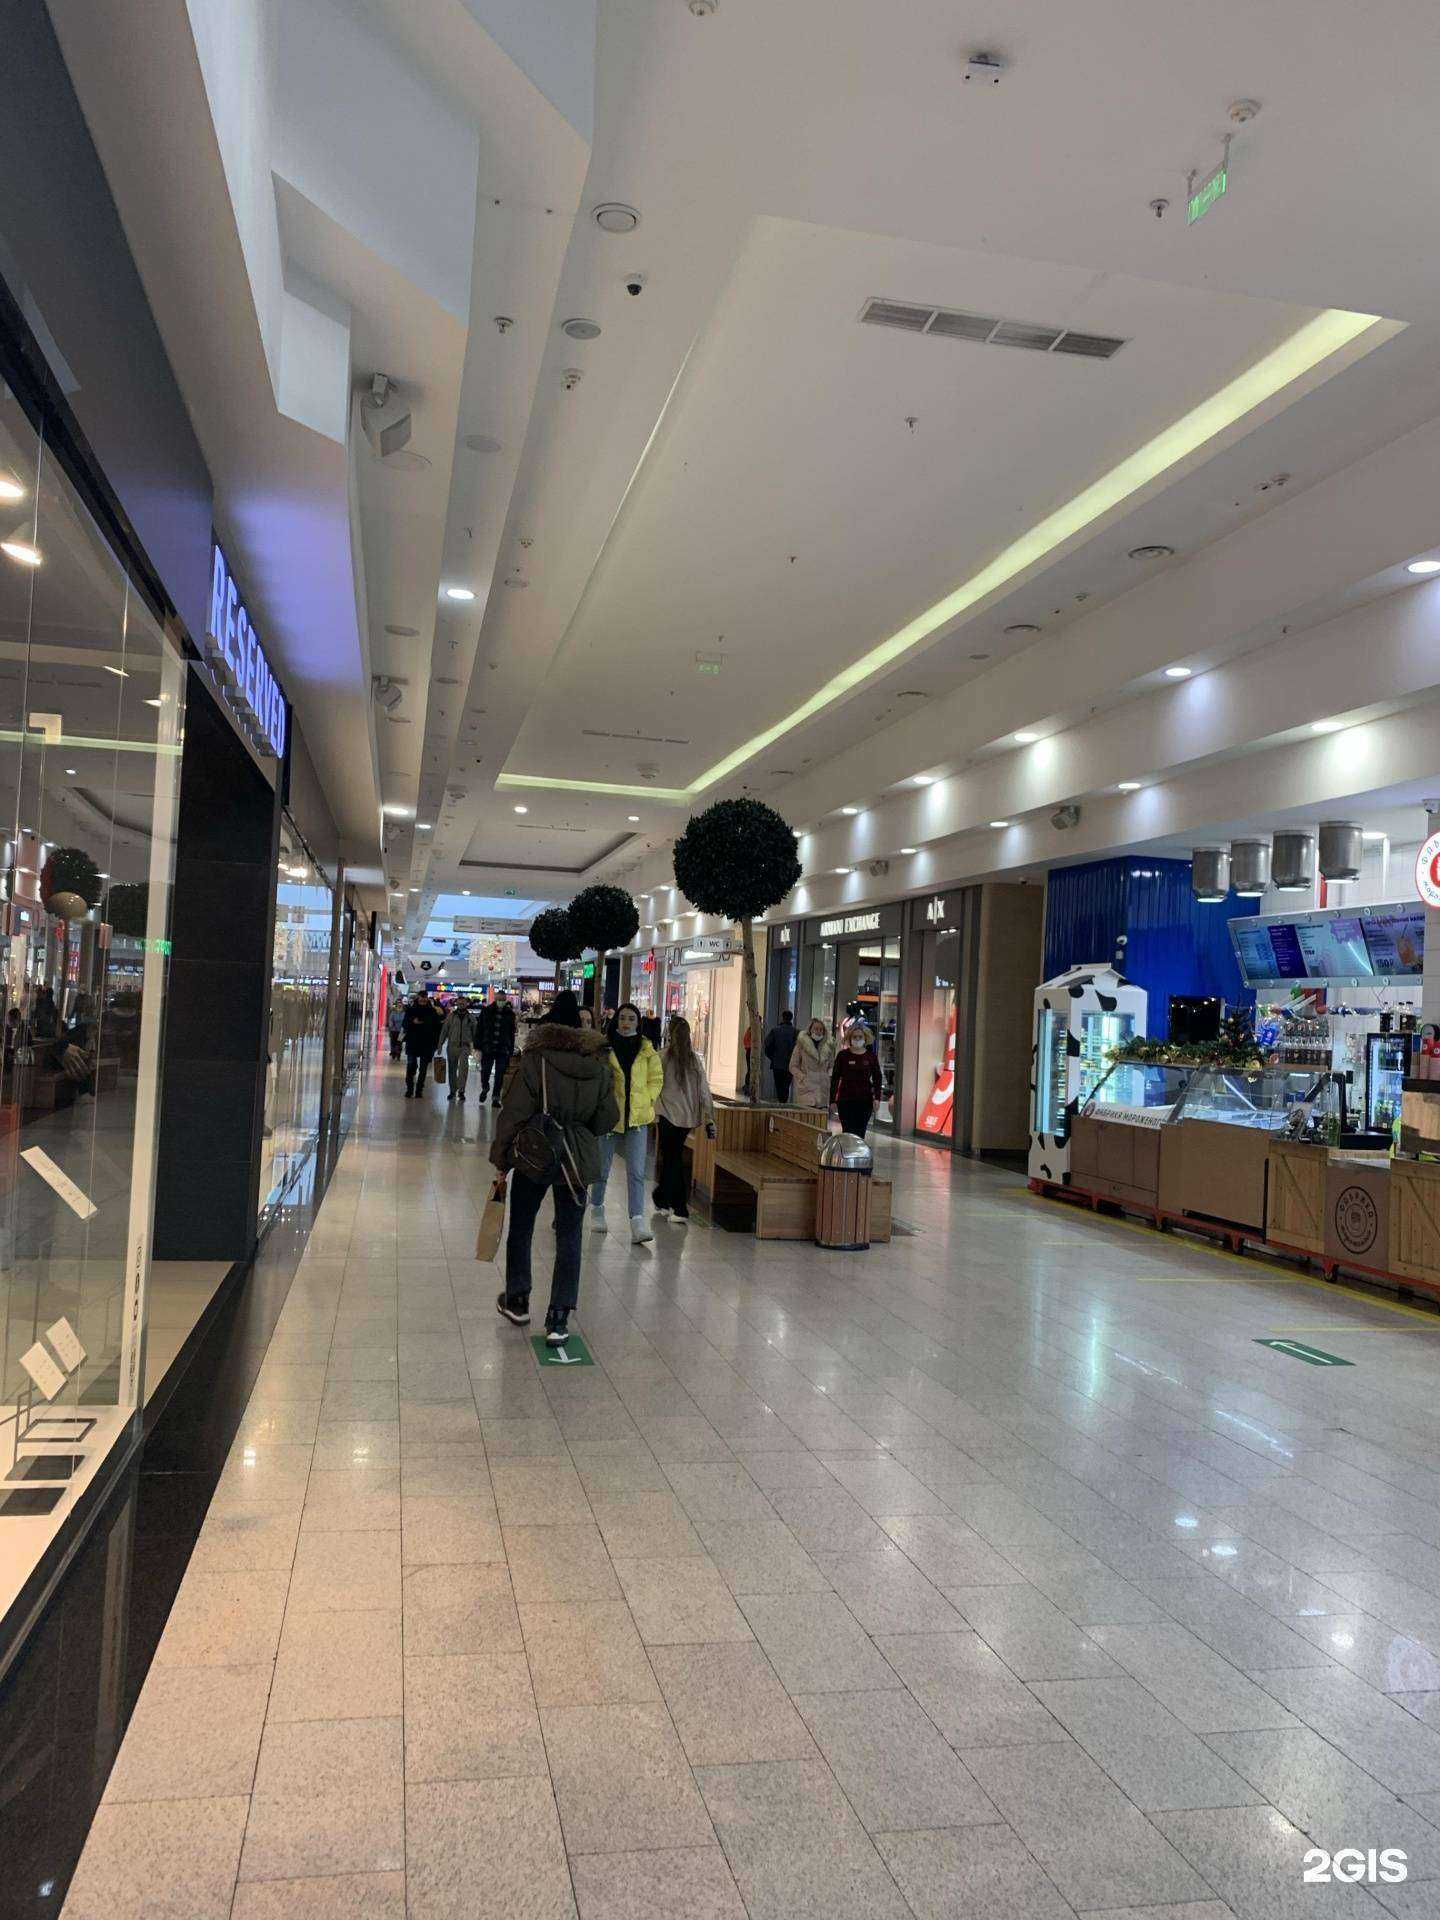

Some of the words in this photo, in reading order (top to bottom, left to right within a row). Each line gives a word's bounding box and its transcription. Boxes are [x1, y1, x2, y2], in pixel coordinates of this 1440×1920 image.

[211, 544, 286, 758] RESERVED
[820, 919, 844, 937] ARMANI
[844, 912, 881, 933] EXCHANGE
